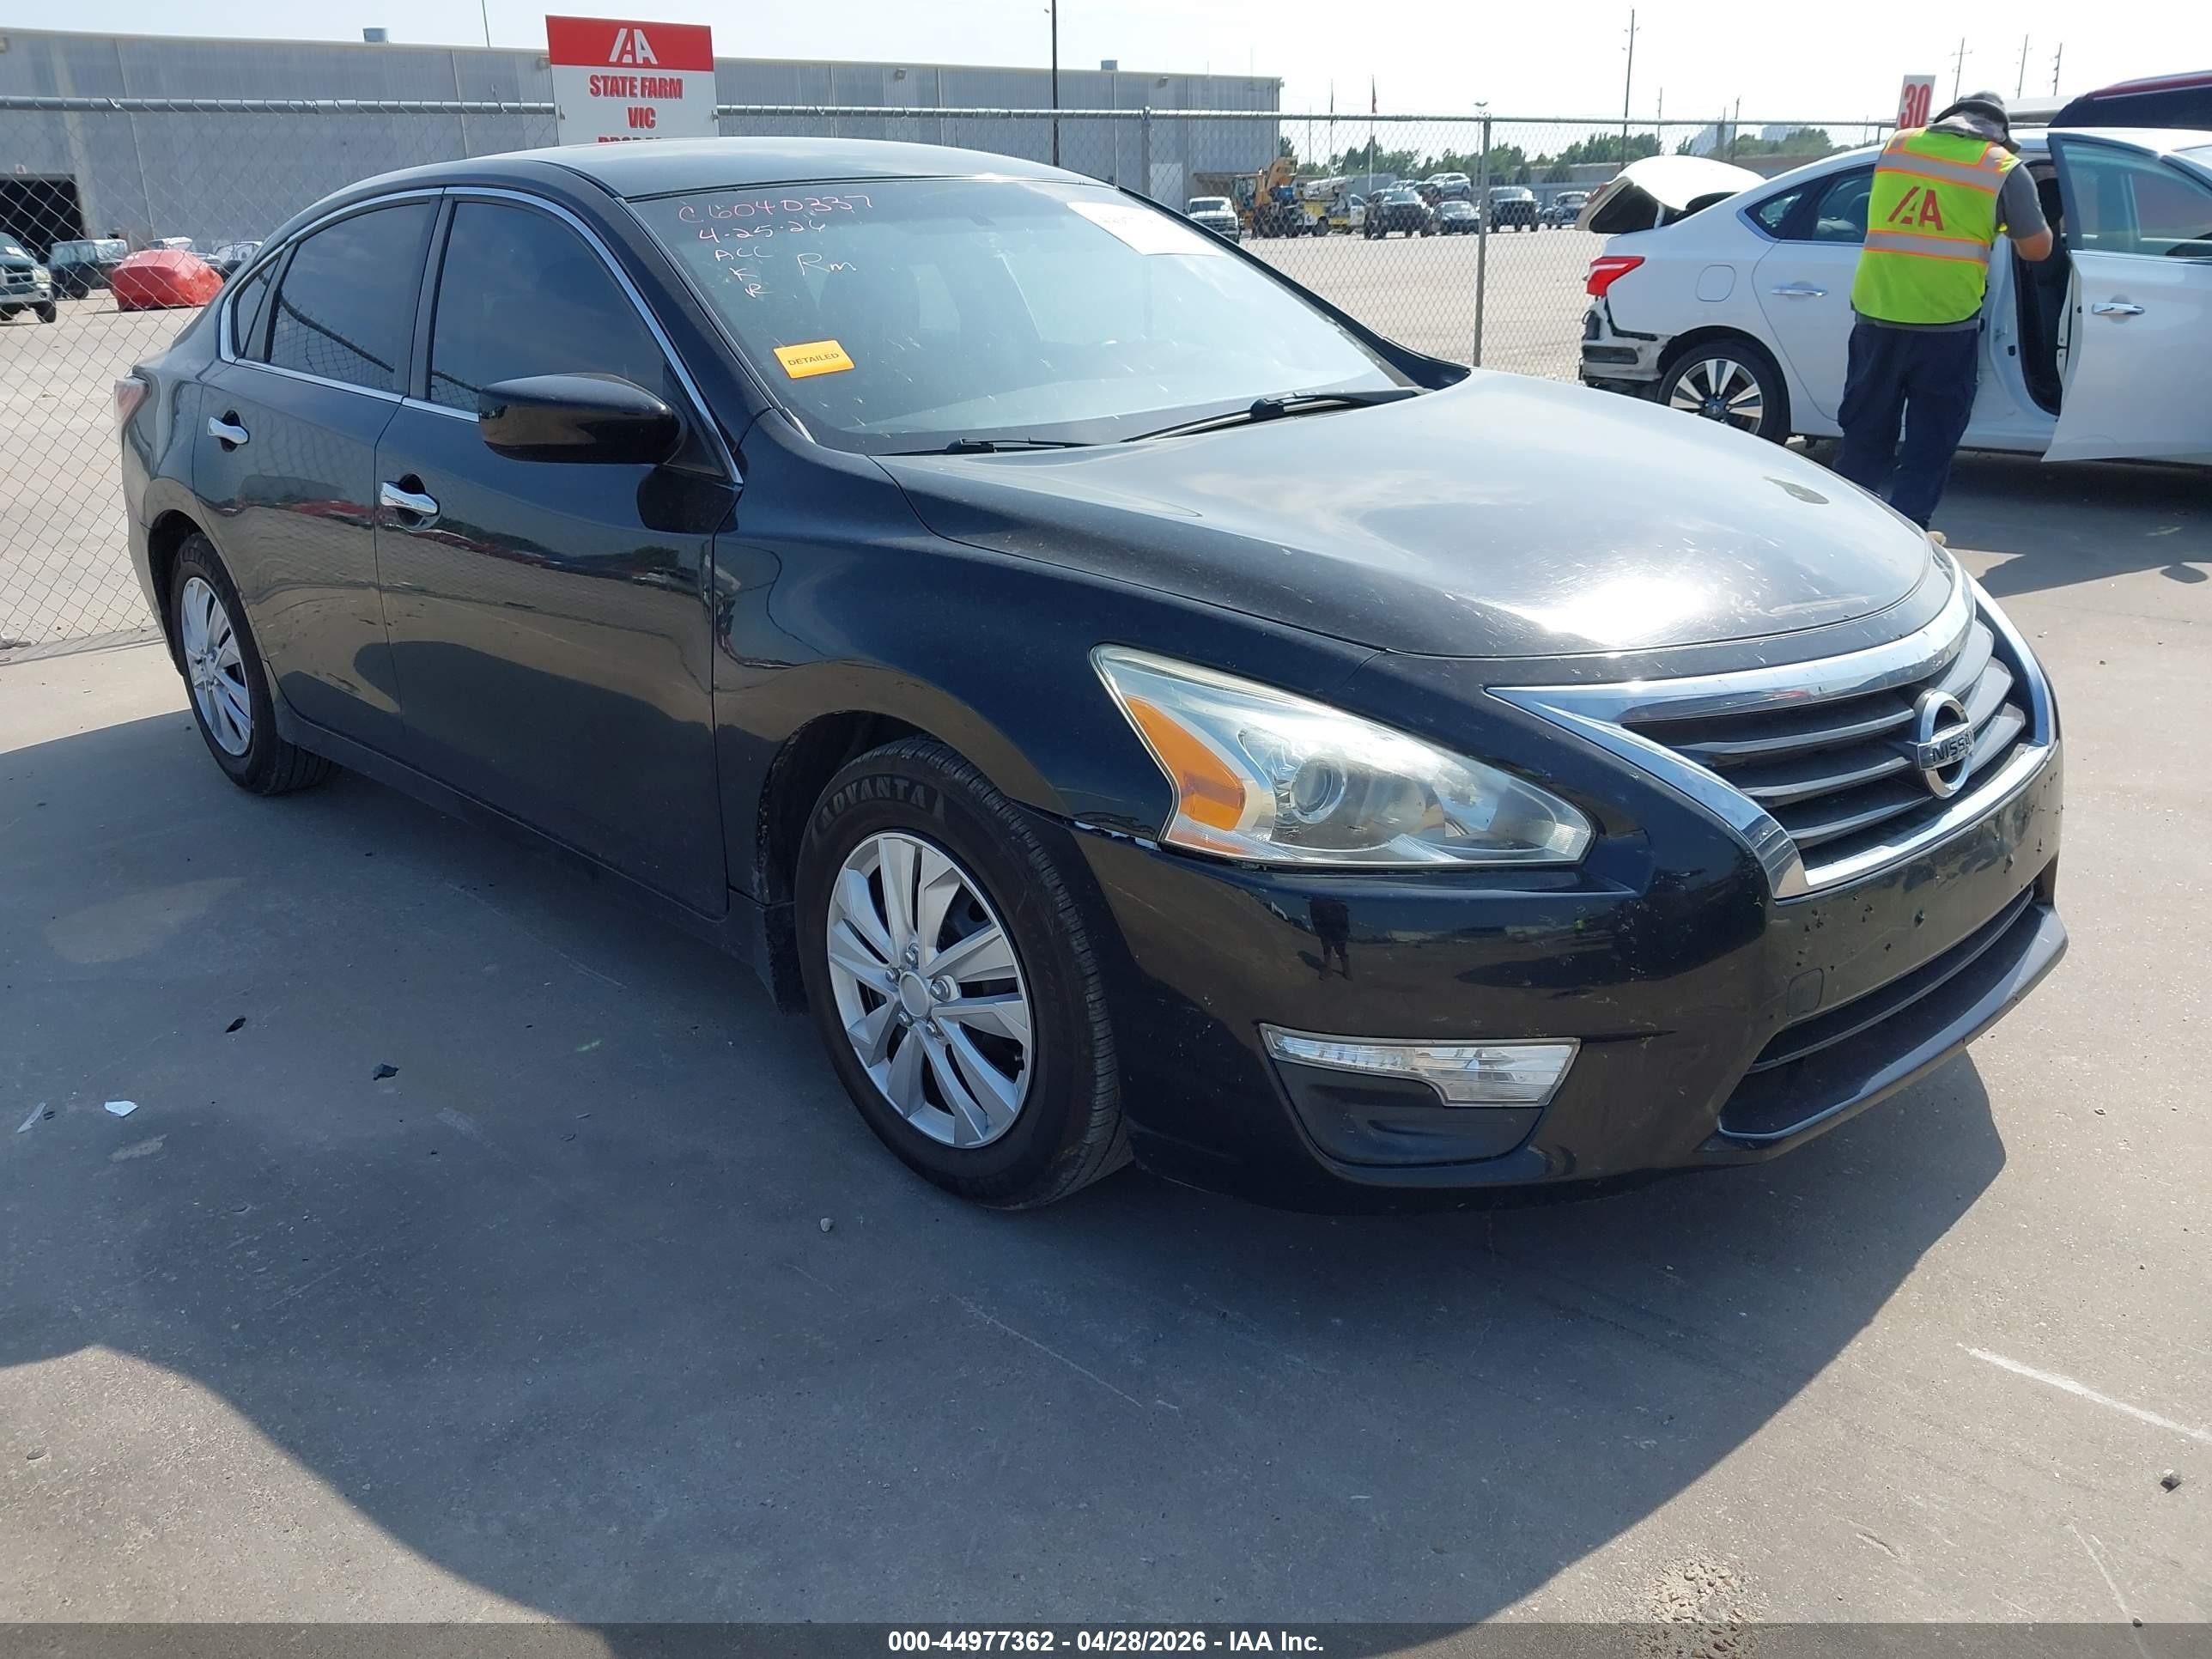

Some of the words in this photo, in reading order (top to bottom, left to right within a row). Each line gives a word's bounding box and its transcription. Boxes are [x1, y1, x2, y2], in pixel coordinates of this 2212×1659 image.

[589, 74, 638, 99] STATE
[640, 76, 684, 100] FARM
[627, 106, 656, 129] VIC
[1899, 82, 1931, 128] 30
[787, 351, 840, 367] DETAILED
[821, 775, 927, 830] ADVANTA
